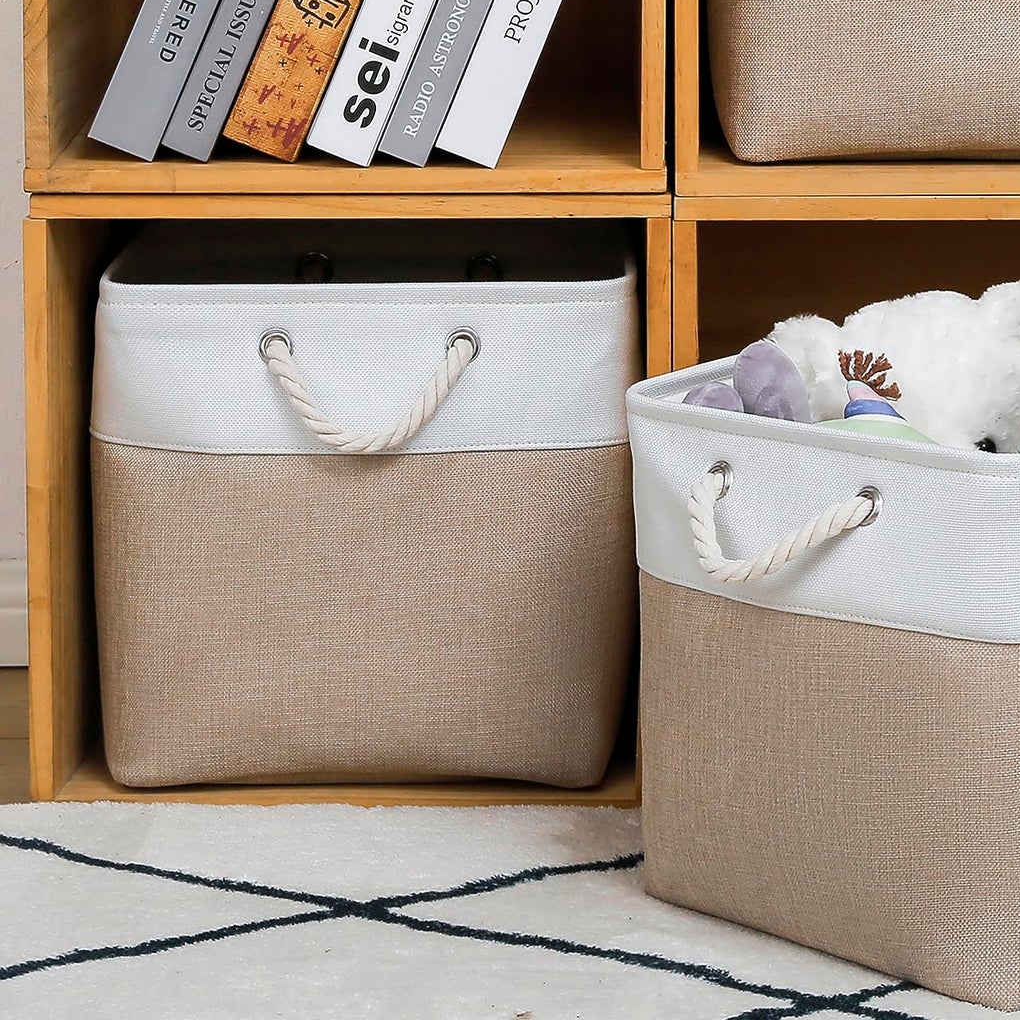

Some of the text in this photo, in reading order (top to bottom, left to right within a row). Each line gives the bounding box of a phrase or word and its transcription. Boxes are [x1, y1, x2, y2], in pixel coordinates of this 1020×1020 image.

[188, 32, 240, 131] SPECIAL
[344, 37, 400, 129] sei
[403, 82, 434, 138] RADIO
